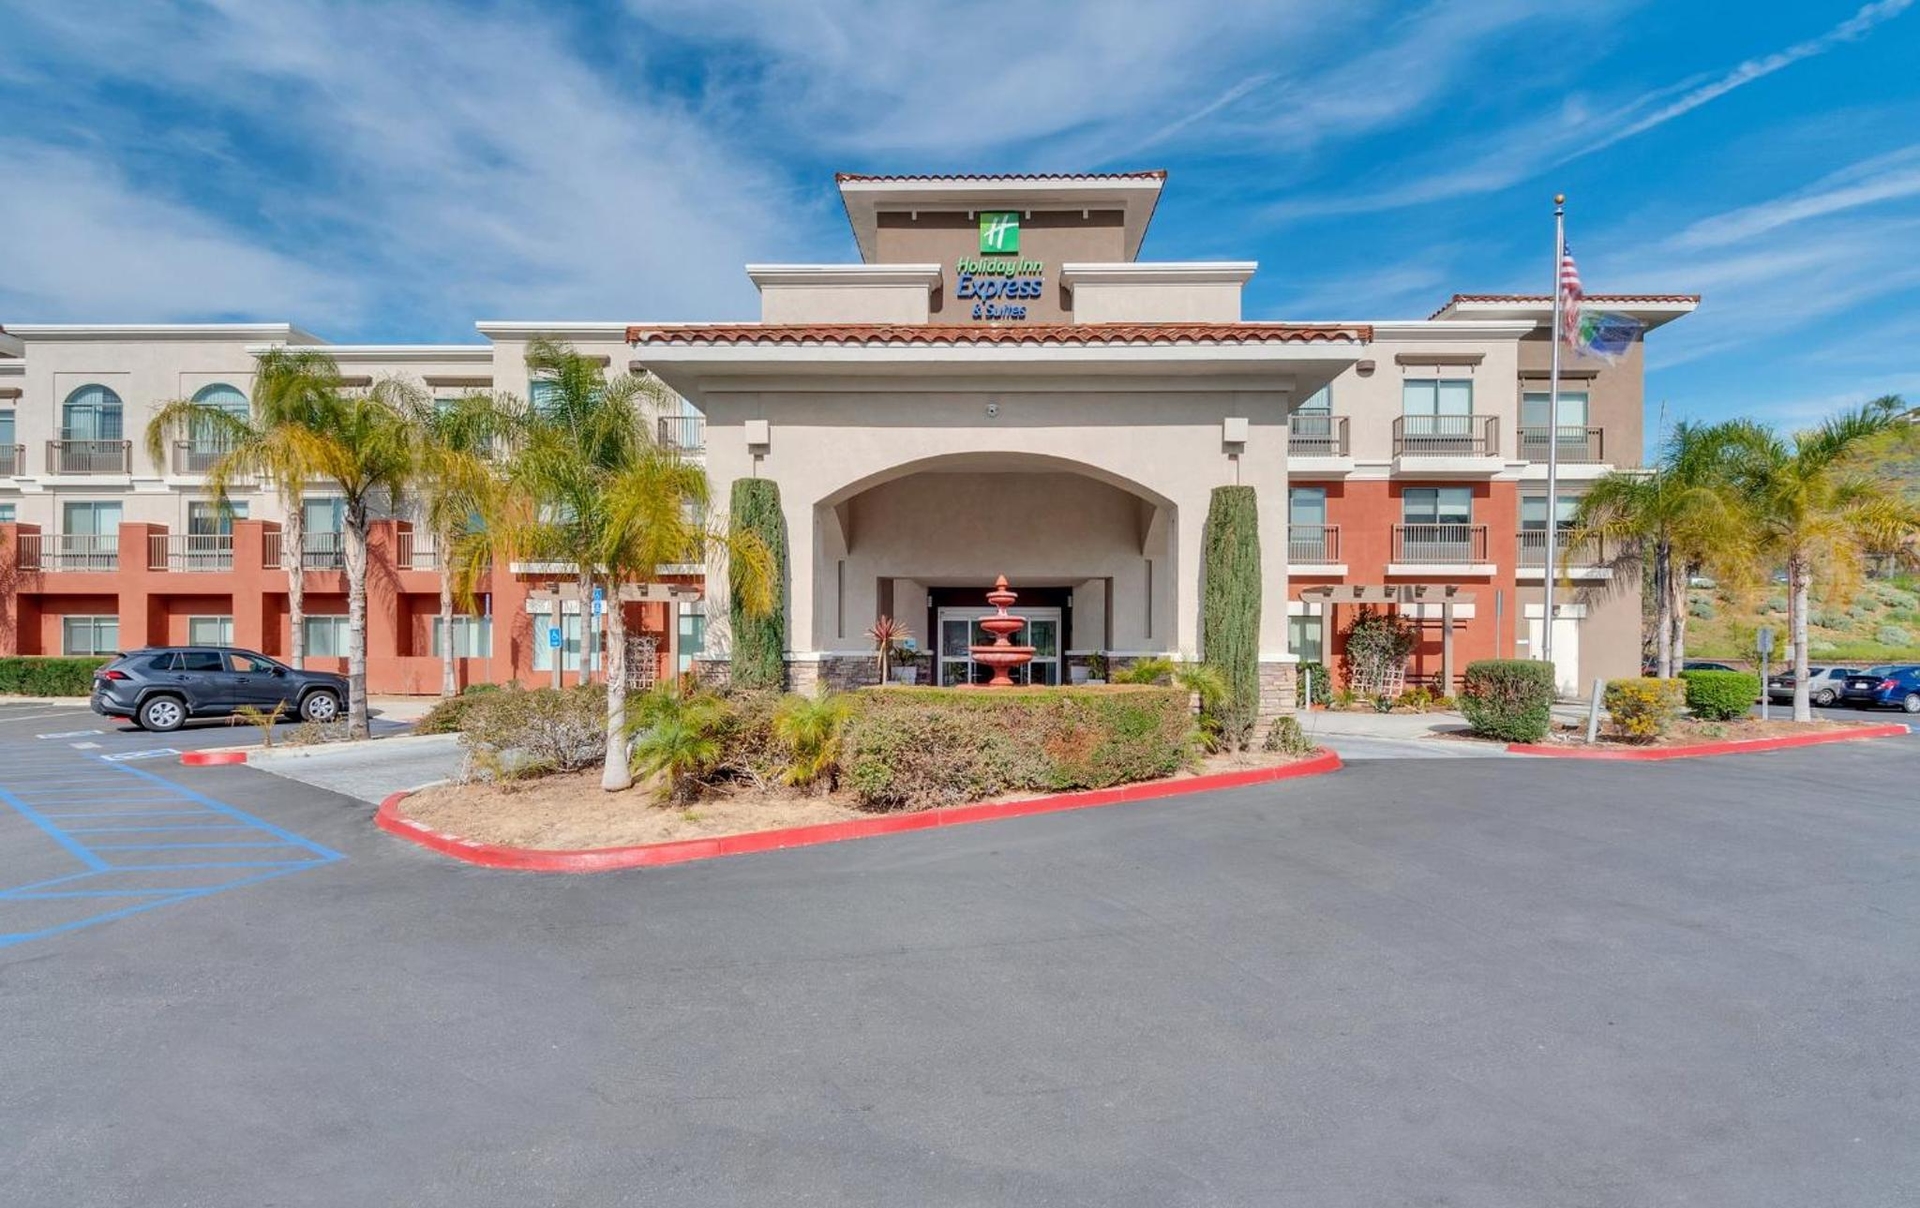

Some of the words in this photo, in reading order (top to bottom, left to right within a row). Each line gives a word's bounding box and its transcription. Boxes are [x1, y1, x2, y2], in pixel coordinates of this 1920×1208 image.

[984, 215, 1019, 249] H
[957, 257, 1016, 276] Holiday
[1018, 256, 1043, 274] Inn
[957, 273, 1043, 301] Express
[972, 304, 983, 318] &
[985, 304, 1027, 318] Suites
